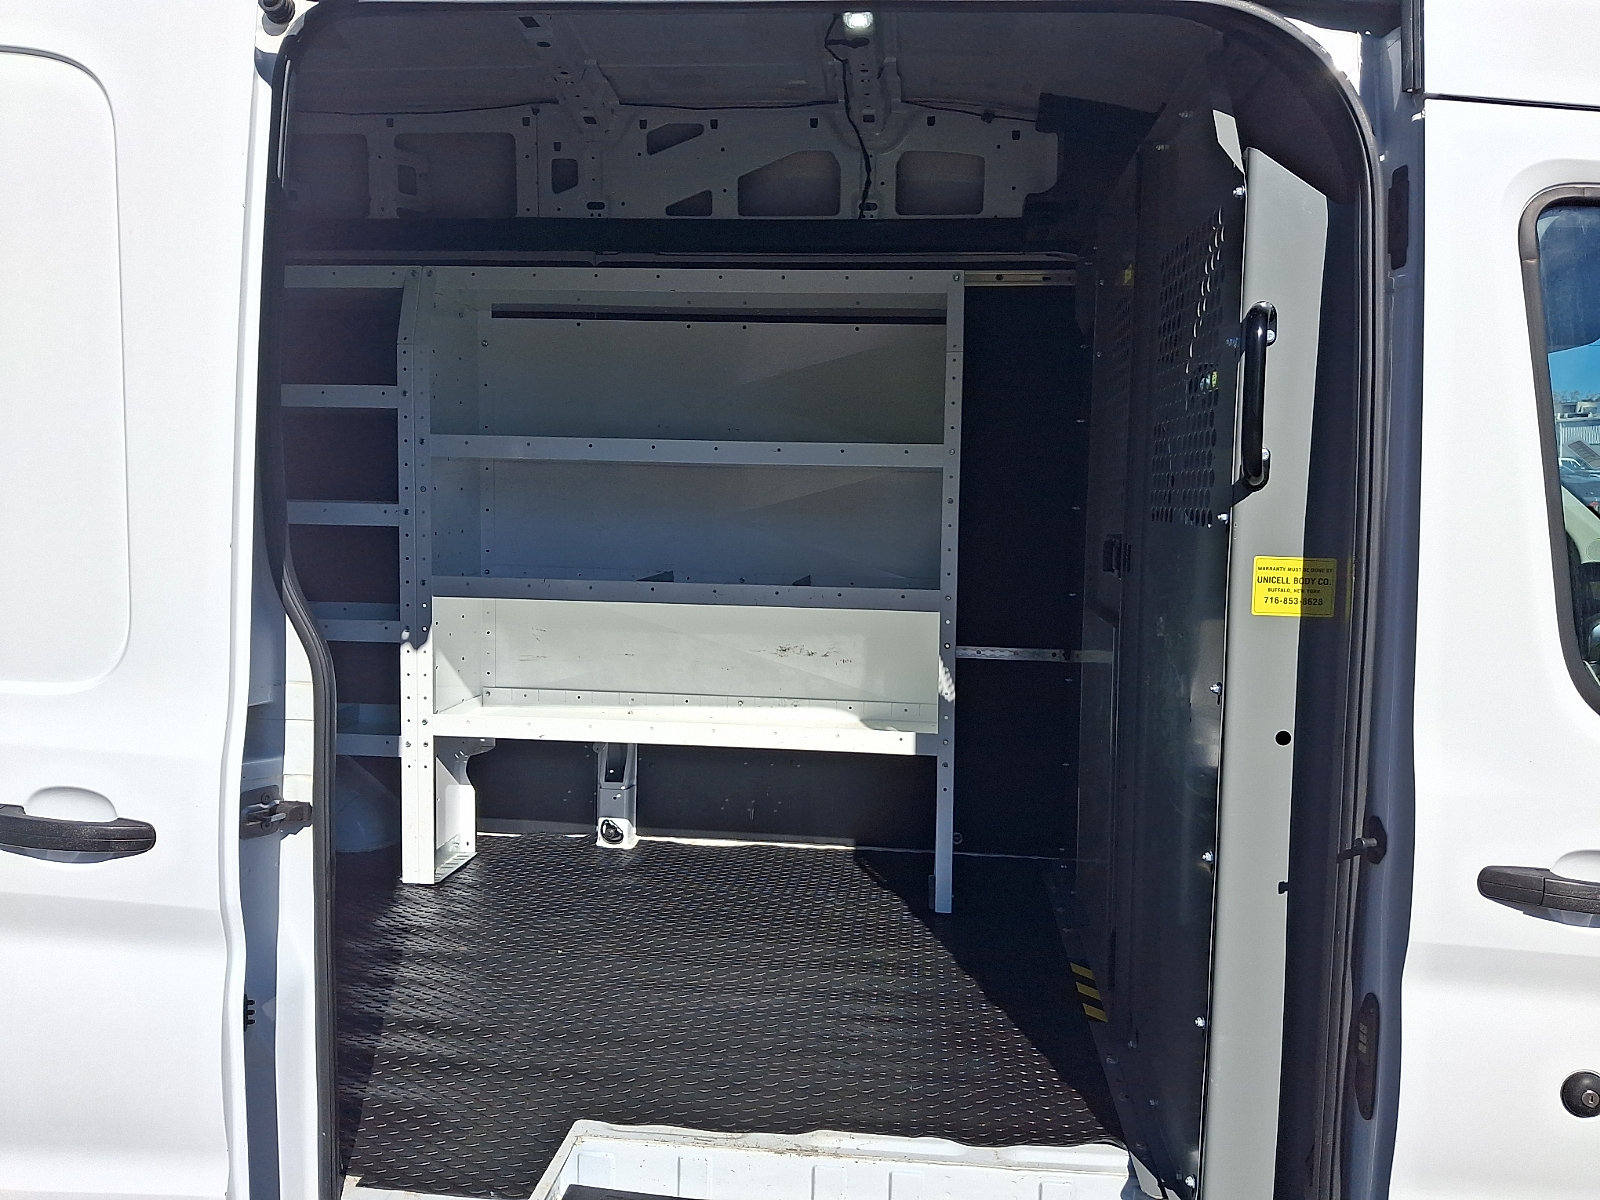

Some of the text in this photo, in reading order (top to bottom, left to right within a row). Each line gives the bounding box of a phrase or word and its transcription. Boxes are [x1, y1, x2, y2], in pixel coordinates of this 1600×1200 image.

[1257, 576, 1332, 586] UNICELL BODY CO.
